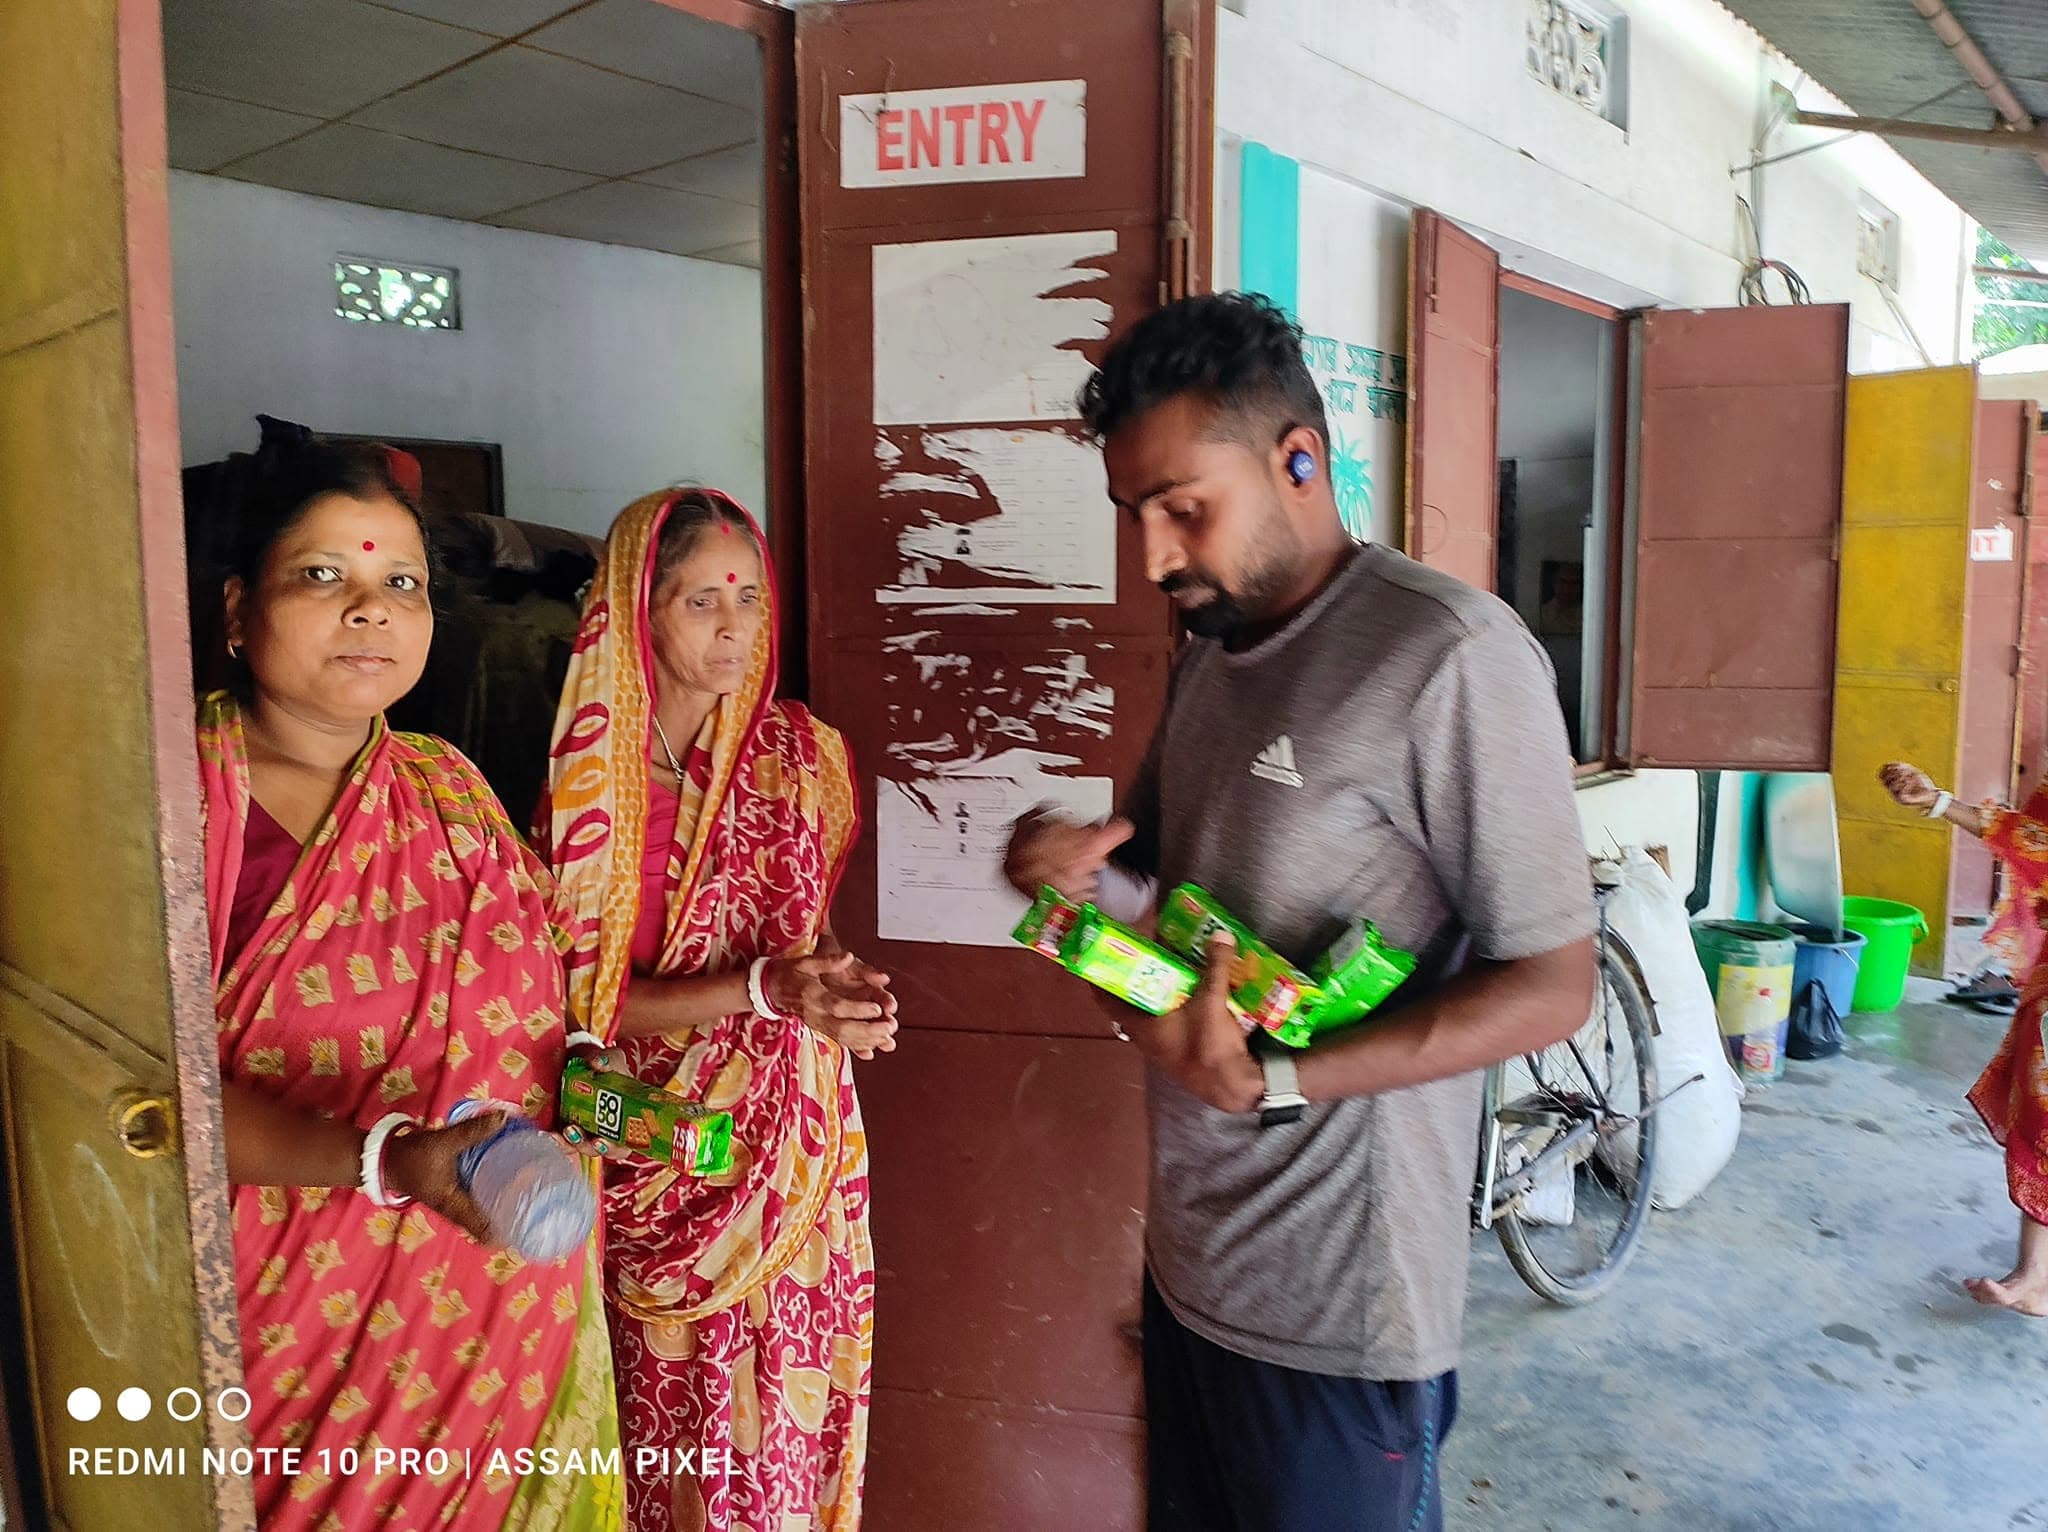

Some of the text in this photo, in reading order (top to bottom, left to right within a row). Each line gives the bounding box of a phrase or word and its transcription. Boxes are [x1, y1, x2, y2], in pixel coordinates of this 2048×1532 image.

[877, 99, 1046, 171] ENTRY
[599, 1092, 618, 1113] 50
[598, 1109, 617, 1128] 50
